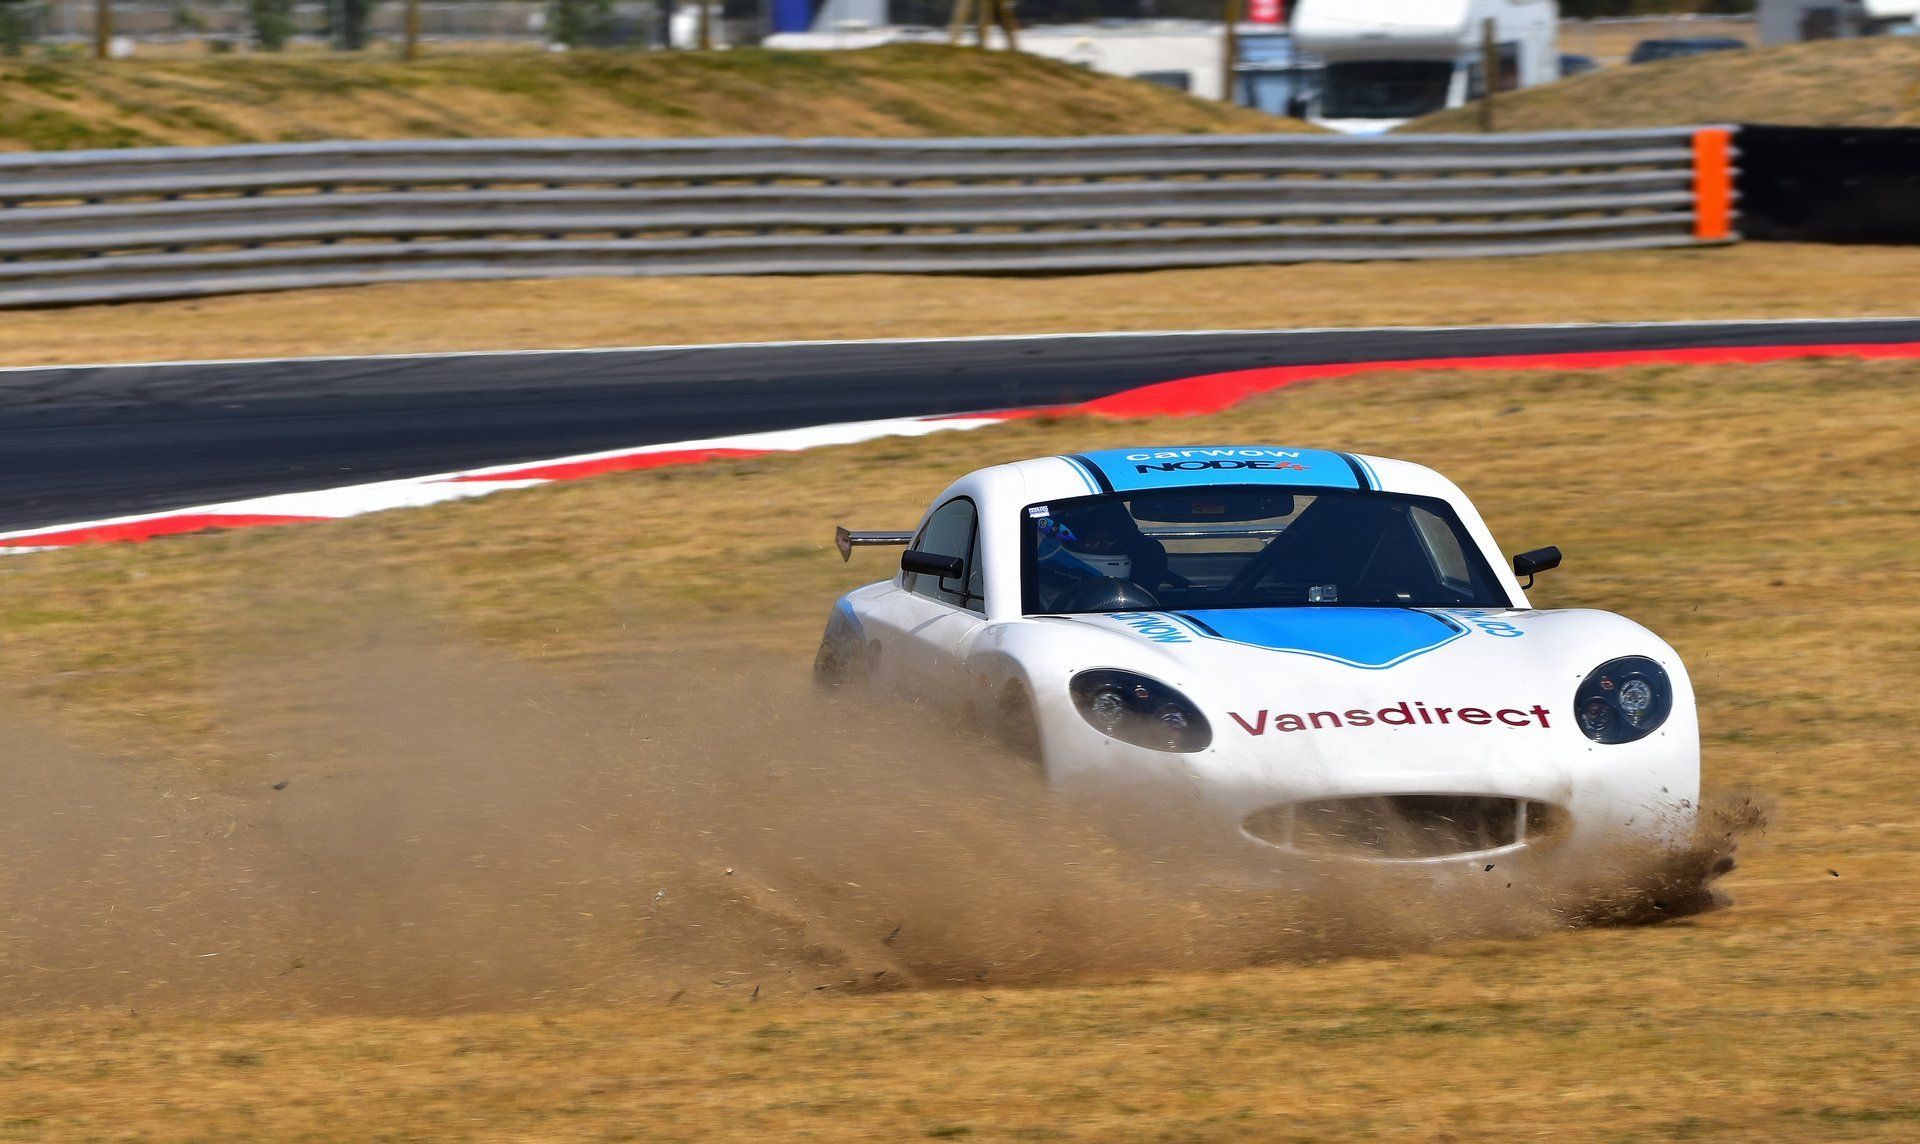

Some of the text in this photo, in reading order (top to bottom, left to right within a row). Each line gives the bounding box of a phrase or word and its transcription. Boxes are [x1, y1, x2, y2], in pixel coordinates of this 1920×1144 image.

[1126, 450, 1300, 462] carwow
[1135, 460, 1311, 474] NODE4
[1103, 612, 1193, 643] arwow
[1227, 701, 1552, 736] Vansdirect
